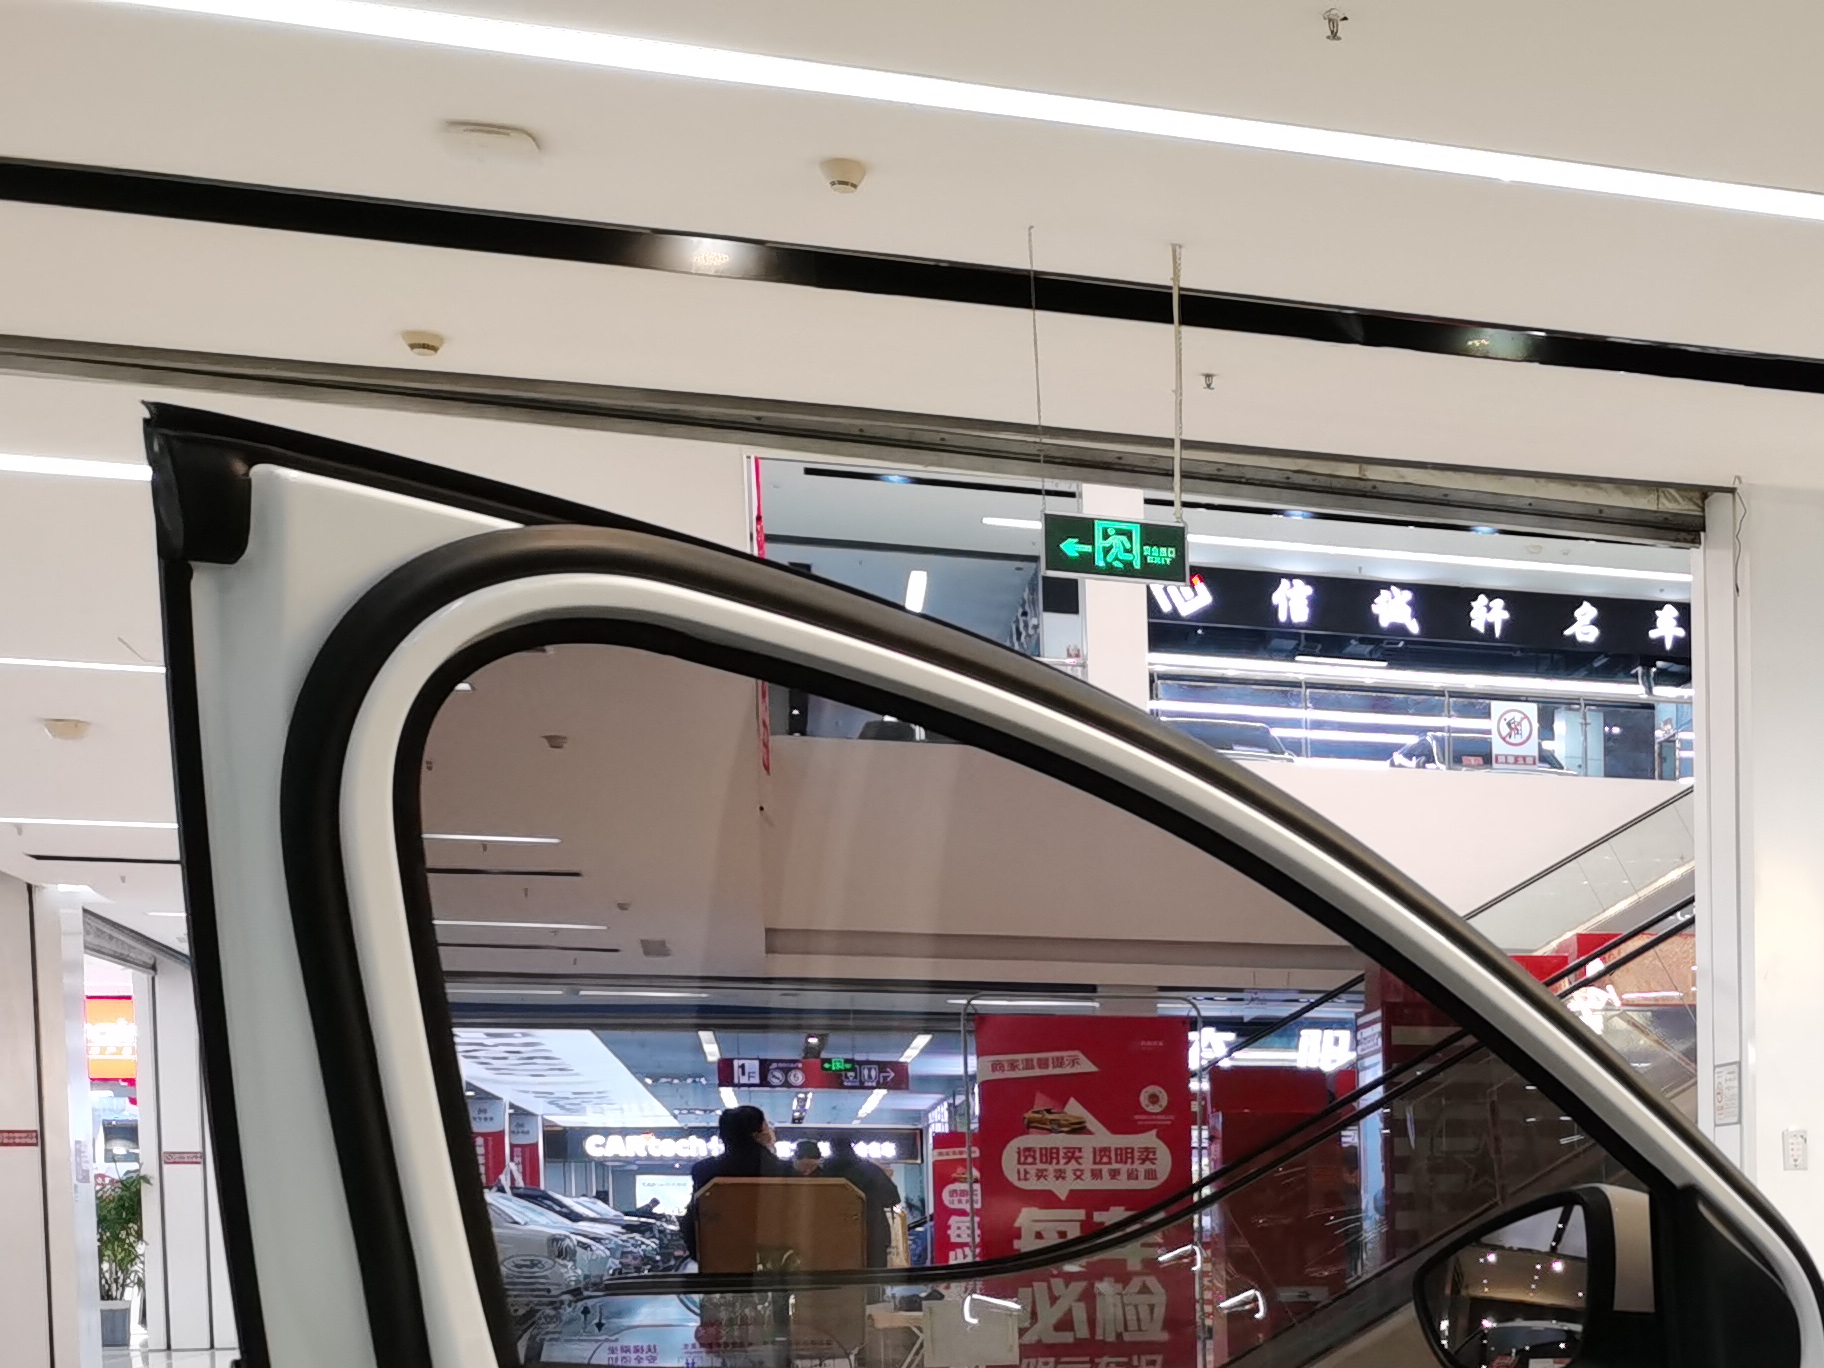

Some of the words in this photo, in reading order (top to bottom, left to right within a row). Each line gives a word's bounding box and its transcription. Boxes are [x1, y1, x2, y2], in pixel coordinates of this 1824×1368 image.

[1147, 556, 1172, 565] EXIT
[1016, 1147, 1084, 1166] 透明买
[1092, 1147, 1158, 1166] 透明卖
[1018, 1275, 1169, 1343] 必检
